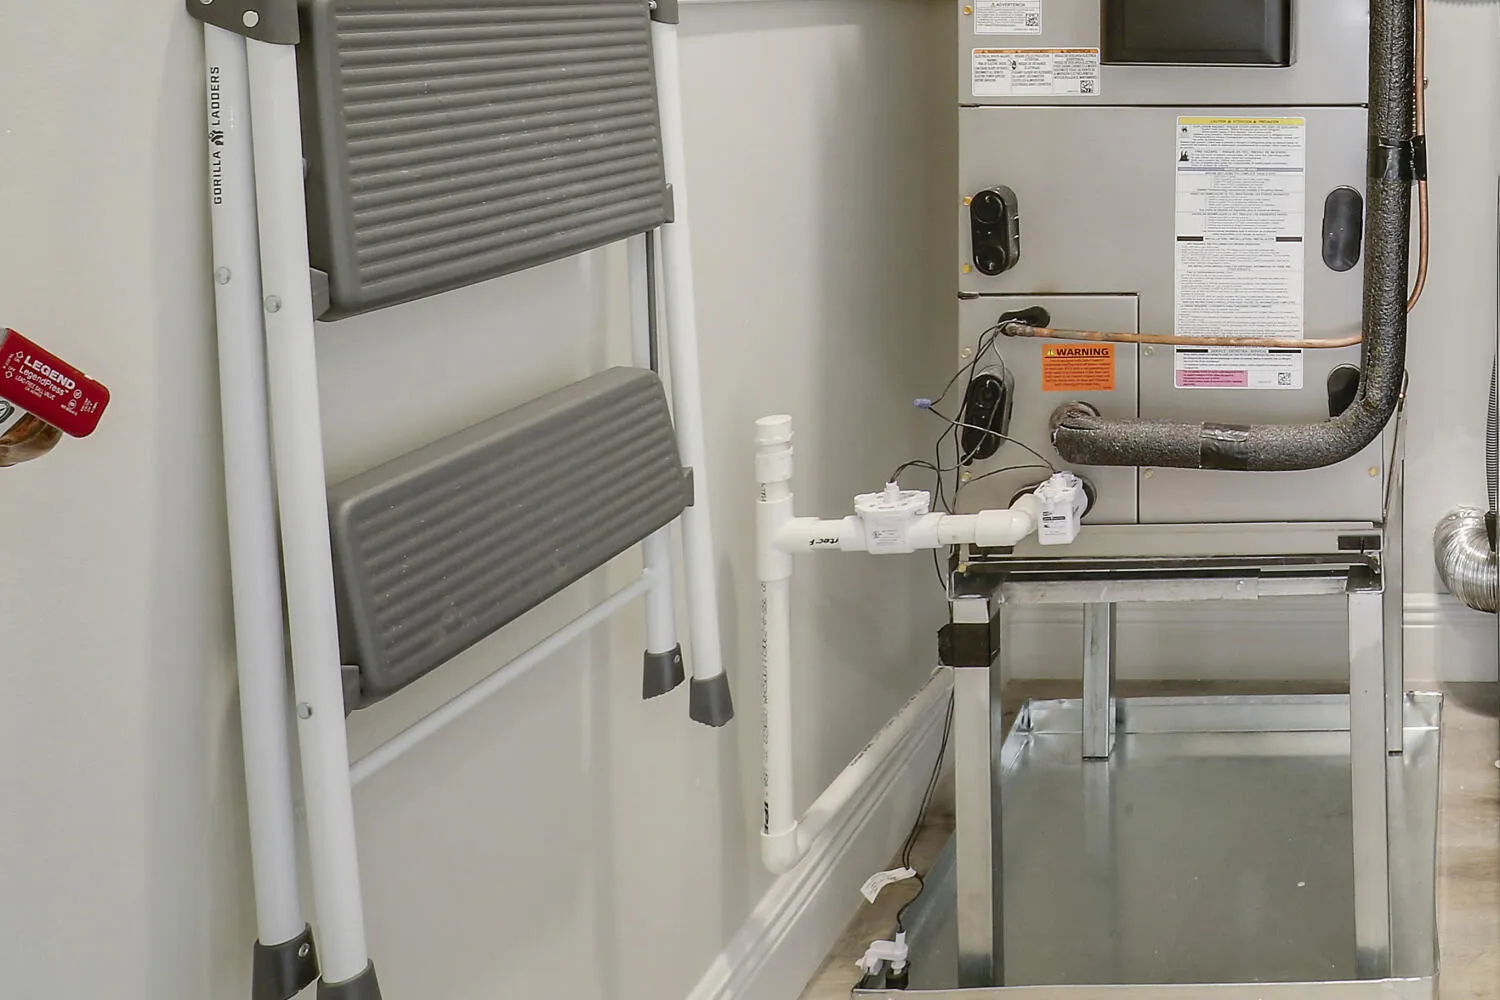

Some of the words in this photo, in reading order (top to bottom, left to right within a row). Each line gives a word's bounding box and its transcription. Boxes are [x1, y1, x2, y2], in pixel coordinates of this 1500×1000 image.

[210, 66, 221, 126] LADDERS
[212, 150, 223, 205] GORILLA
[23, 355, 76, 390] LEGEND
[1056, 347, 1109, 356] WARNING
